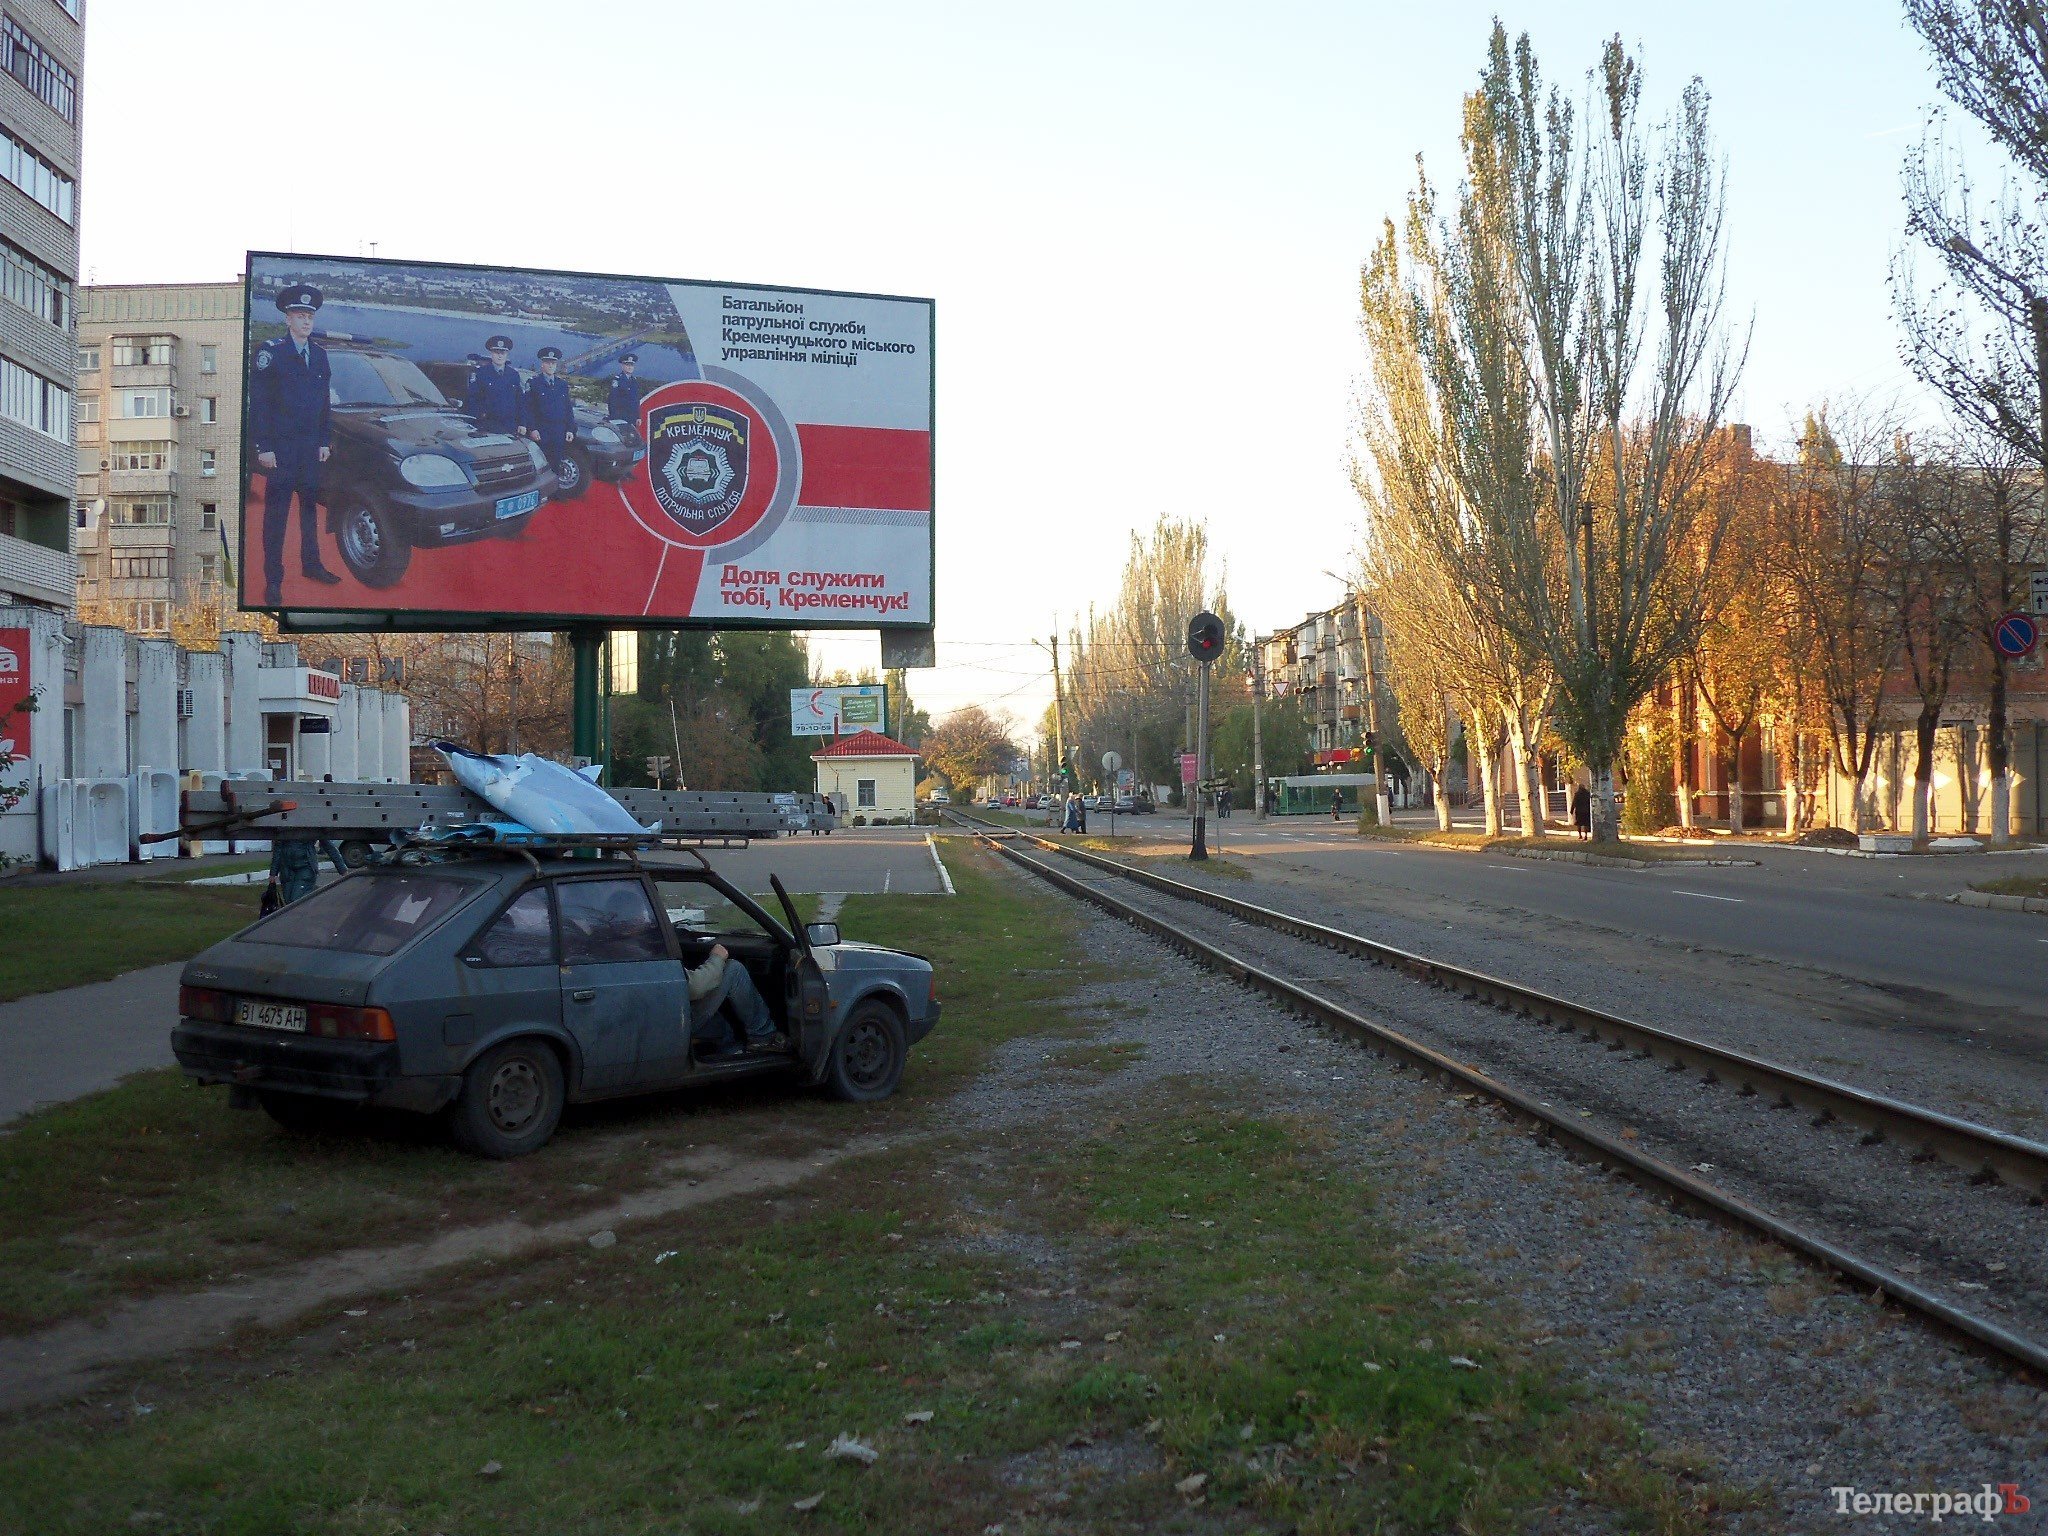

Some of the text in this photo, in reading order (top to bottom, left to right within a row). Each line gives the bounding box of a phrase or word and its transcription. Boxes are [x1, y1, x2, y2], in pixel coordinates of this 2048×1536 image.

[722, 296, 804, 314] Батальйон
[722, 314, 866, 336] патрульної служби
[722, 328, 916, 354] Кременчуцького міського
[721, 347, 858, 367] управління міліції
[666, 424, 733, 442] КРЕМЕНЧУК
[656, 487, 741, 520] ПАТРУЛЬНА СЛУЖБА
[720, 565, 885, 591] Доля служити
[720, 588, 909, 613] тобі, Кременчук!
[258, 1006, 284, 1026] 4675
